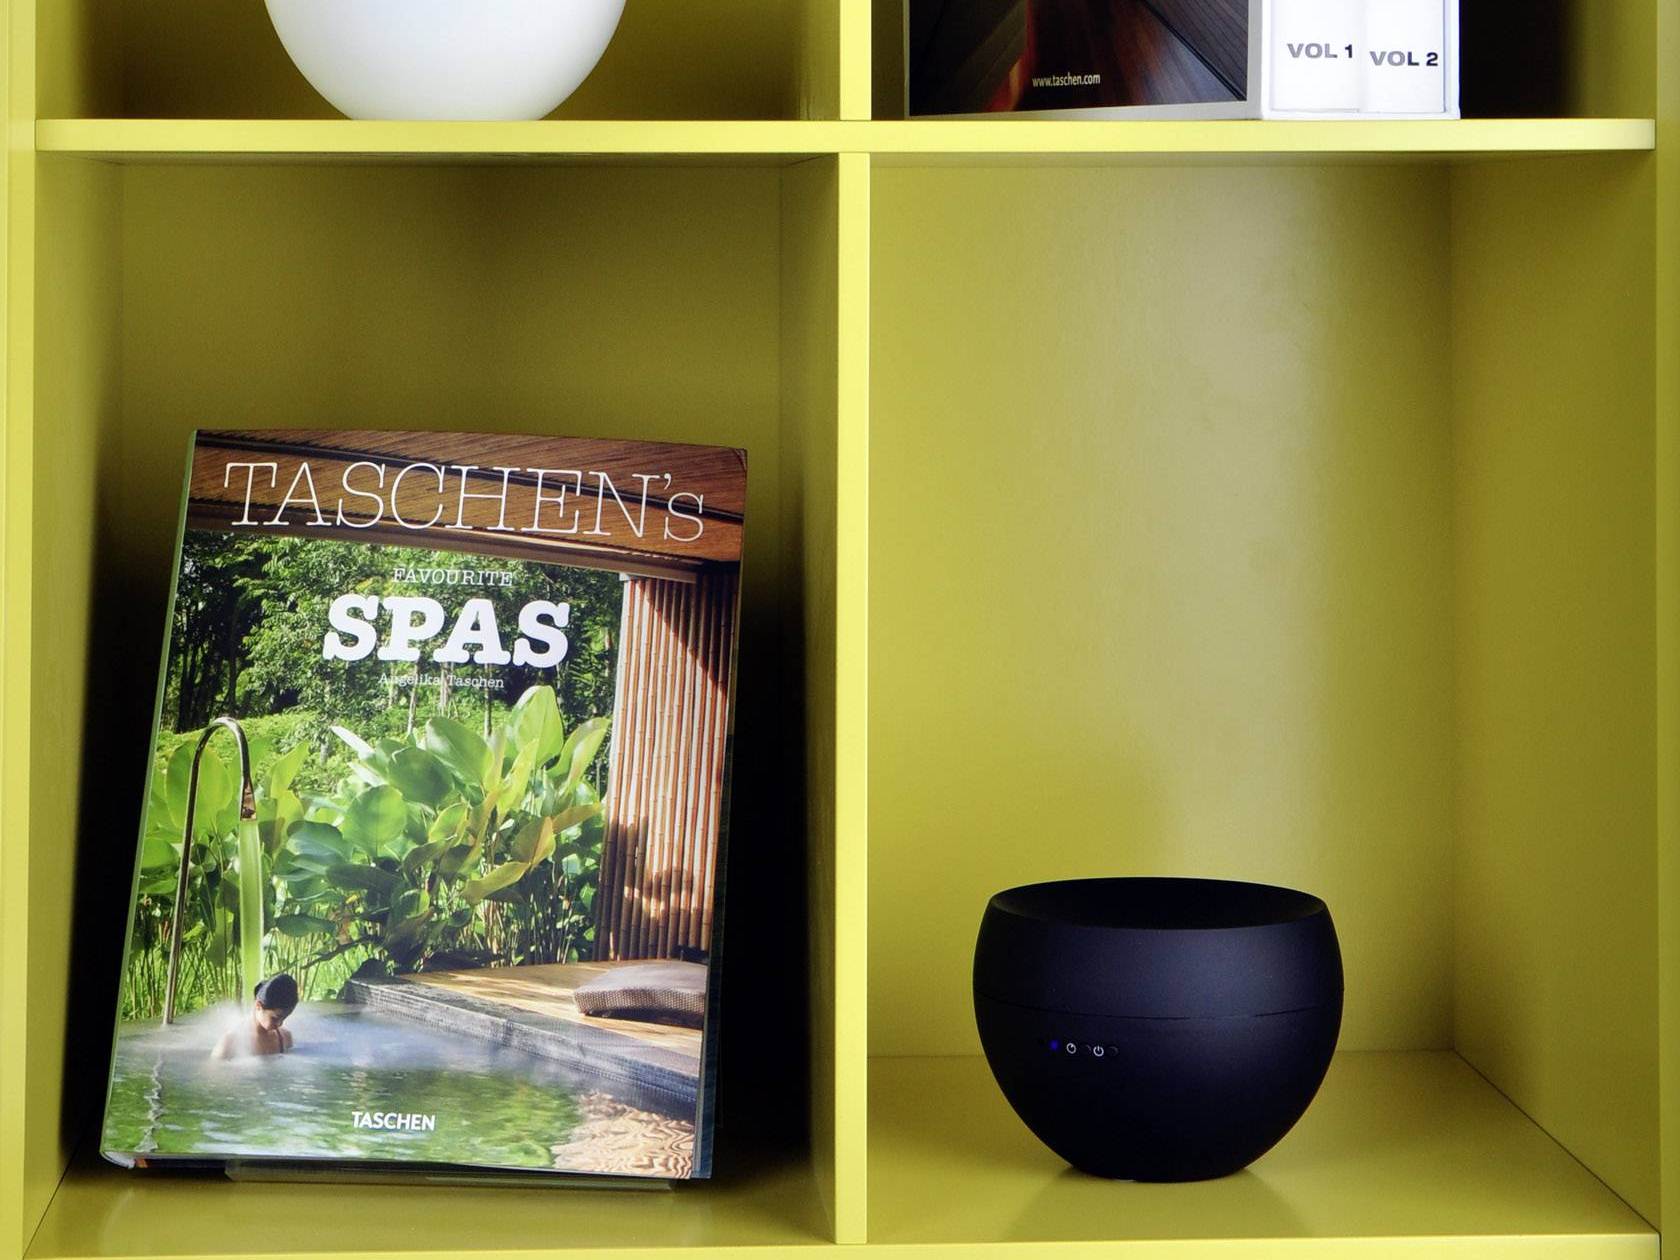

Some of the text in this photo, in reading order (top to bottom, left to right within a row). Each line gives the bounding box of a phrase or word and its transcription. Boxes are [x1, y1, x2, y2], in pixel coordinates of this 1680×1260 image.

[1287, 43, 1354, 59] VOL 1
[1369, 51, 1439, 67] VOL 2
[1032, 72, 1100, 88] www.taschen.com
[393, 567, 514, 588] FAVOURITE
[323, 593, 570, 668] SPAS
[378, 674, 505, 689] Angelika Taschen
[351, 1111, 437, 1132] TASCHEN
